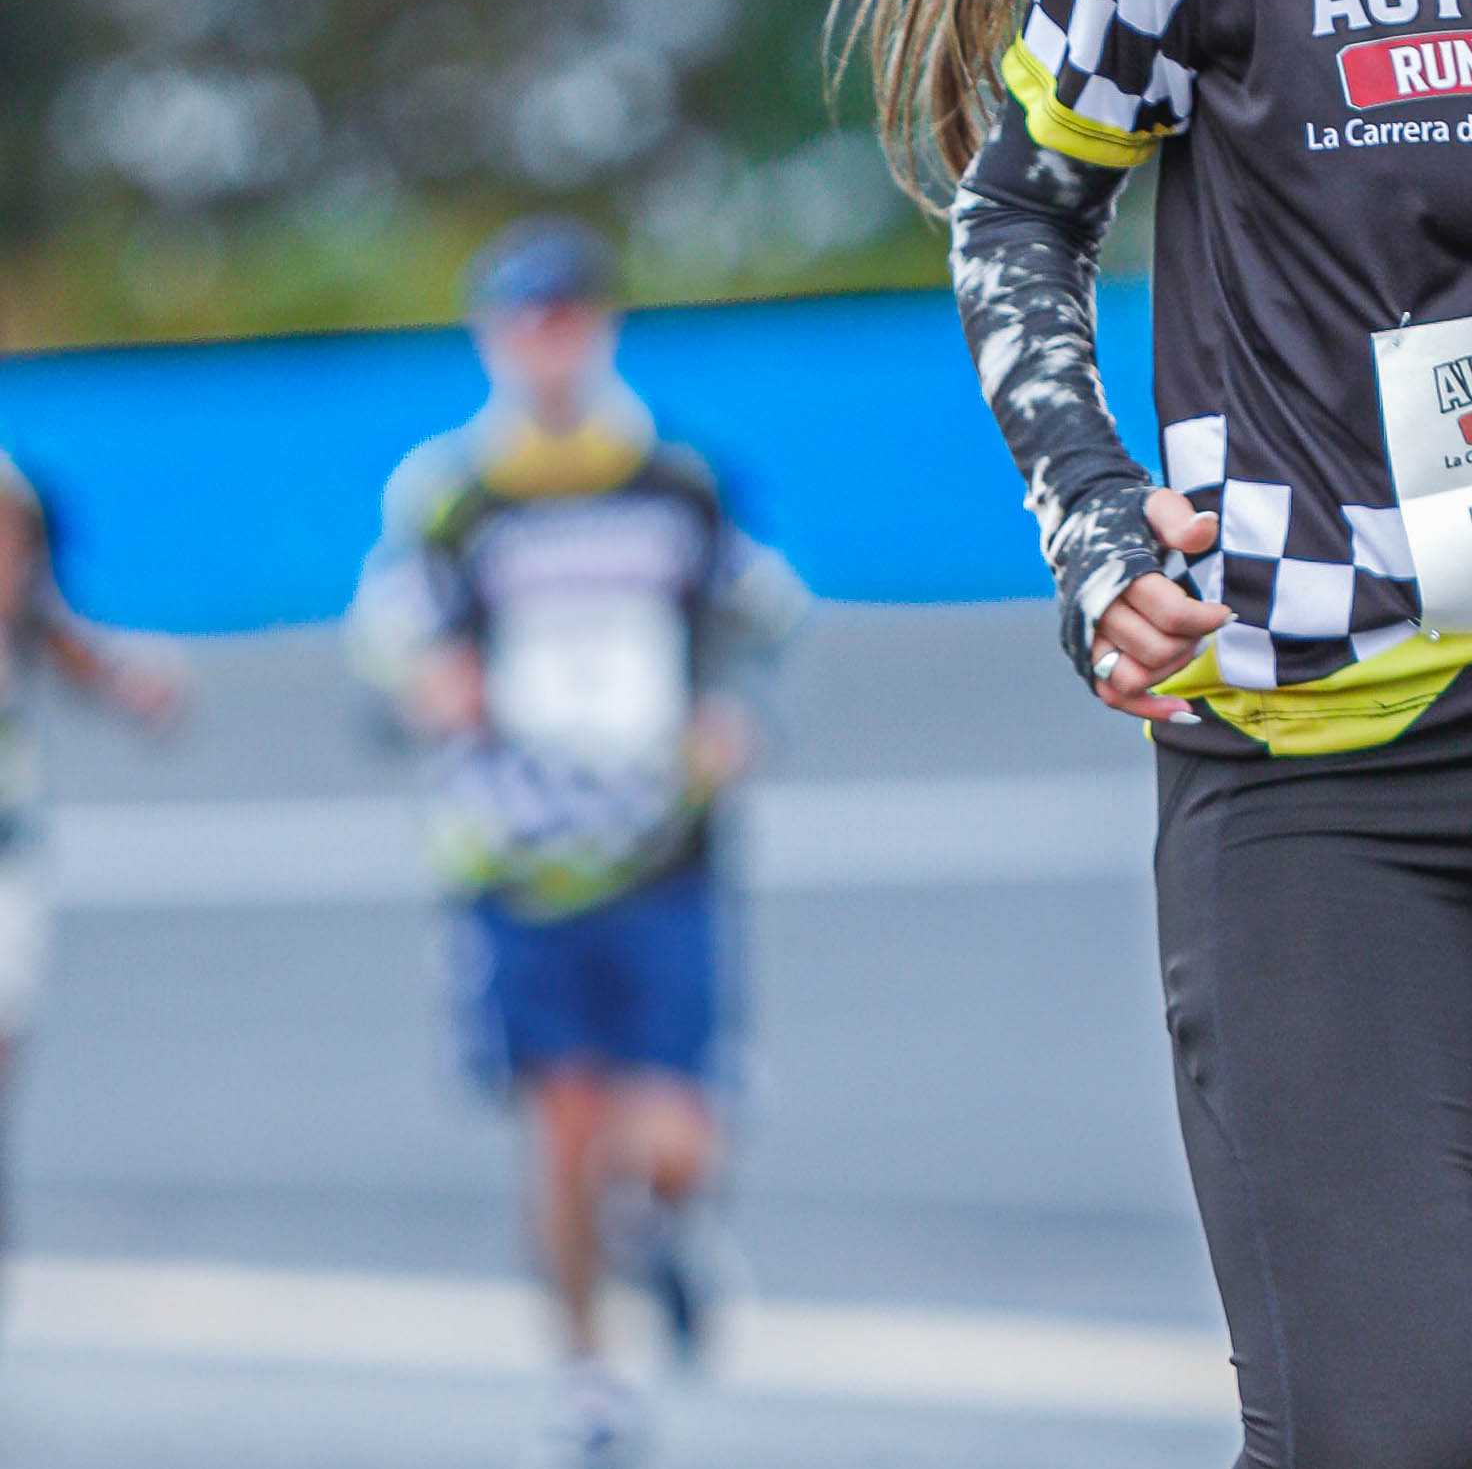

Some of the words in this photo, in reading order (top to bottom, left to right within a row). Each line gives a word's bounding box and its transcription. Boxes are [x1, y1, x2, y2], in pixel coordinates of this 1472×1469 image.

[1305, 122, 1340, 151] La
[1344, 117, 1451, 148] Carrera
[1444, 454, 1462, 470] La
